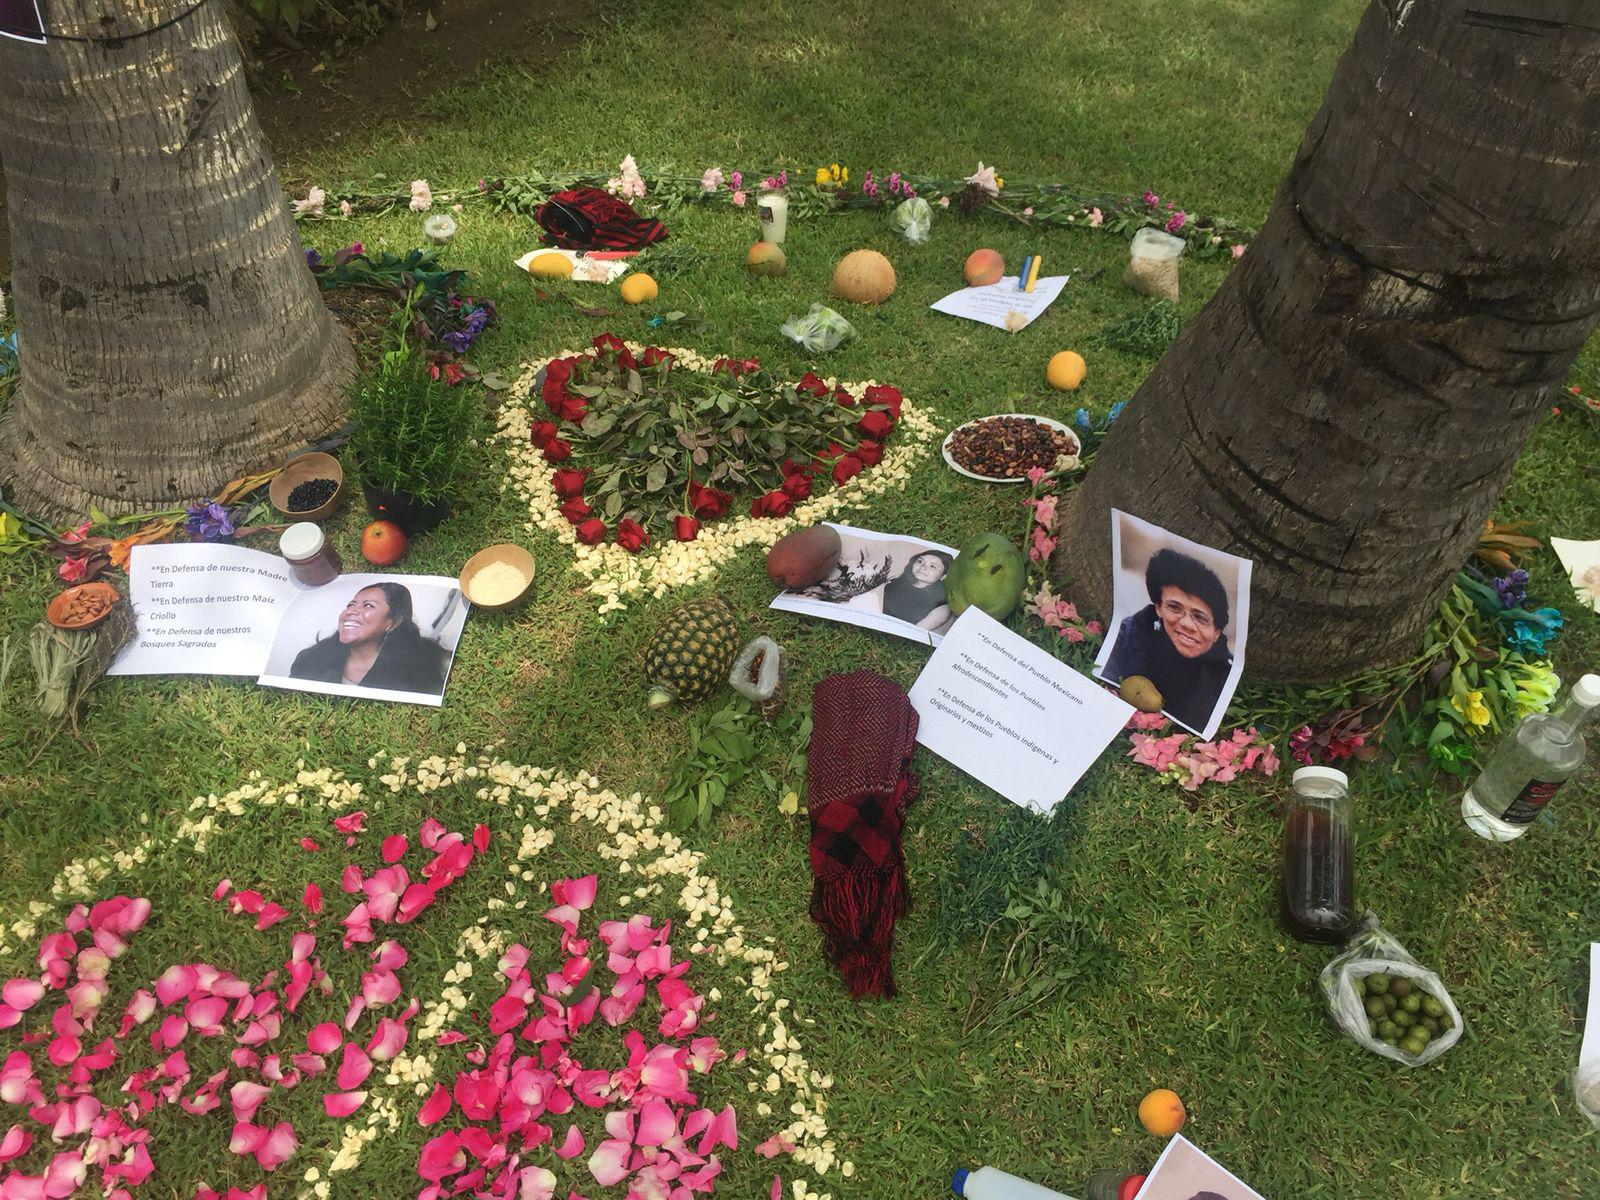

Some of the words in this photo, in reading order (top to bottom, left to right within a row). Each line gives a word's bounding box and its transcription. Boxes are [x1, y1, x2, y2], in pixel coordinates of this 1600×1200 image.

[172, 564, 205, 573] Defensa
[206, 563, 218, 572] de
[220, 565, 256, 574] nuestra
[257, 569, 288, 582] Madre
[150, 580, 173, 589] Tierra
[172, 595, 203, 605] Defensa
[205, 594, 215, 603] de
[217, 594, 250, 603] nuestro
[150, 611, 176, 620] Criollo
[168, 627, 203, 636] Defensa
[204, 626, 214, 635] de
[217, 625, 251, 635] nuestros
[140, 641, 175, 649] Bosques
[177, 640, 217, 648] Sagrados
[952, 663, 1008, 699] Afrodescendientes
[992, 642, 1017, 662] Defensa
[1017, 659, 1029, 670] del
[1029, 667, 1051, 684] Pueblo
[1051, 681, 1083, 706] Mexicano
[974, 662, 1000, 681] Defensa
[1000, 677, 1010, 687] de
[1009, 684, 1020, 694] los
[1020, 691, 1046, 711] Pueblos
[930, 697, 961, 720] Originarios
[961, 716, 968, 724] y
[966, 720, 993, 738] mestizos
[951, 696, 976, 713] Defensa
[975, 710, 985, 719] de
[984, 714, 995, 725] los
[995, 721, 1021, 740] Pueblos
